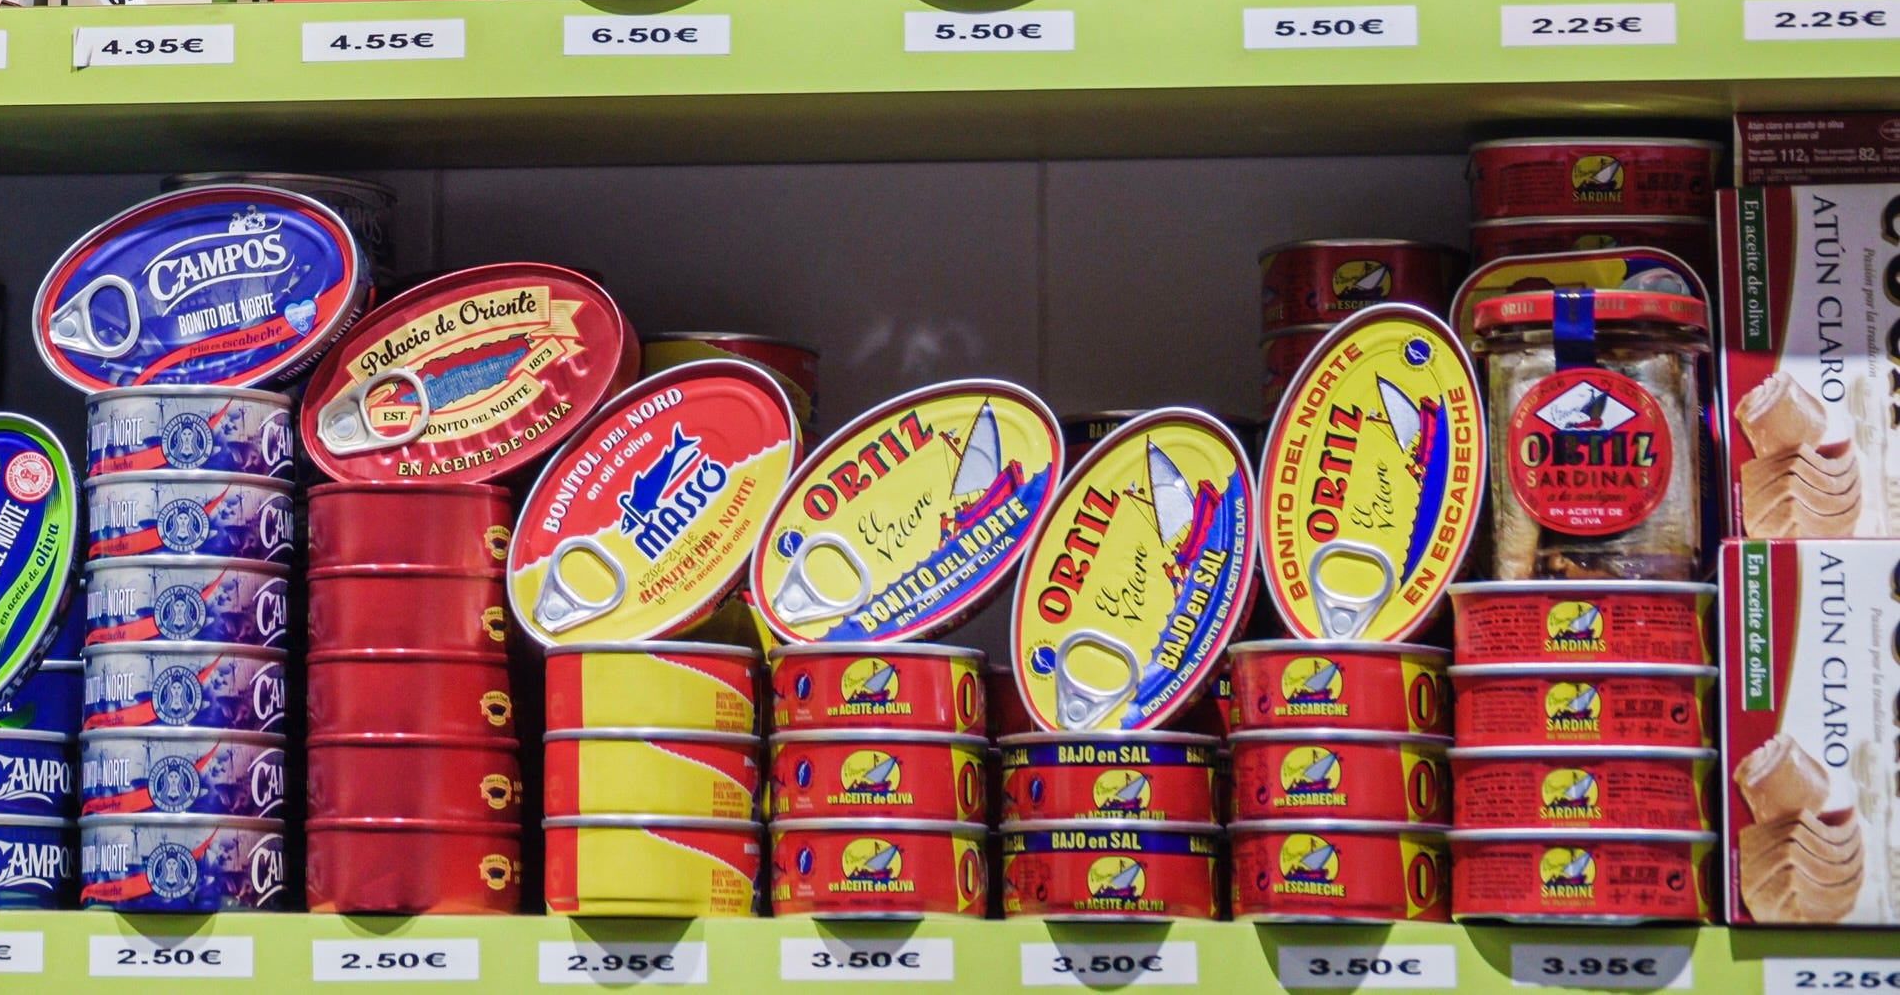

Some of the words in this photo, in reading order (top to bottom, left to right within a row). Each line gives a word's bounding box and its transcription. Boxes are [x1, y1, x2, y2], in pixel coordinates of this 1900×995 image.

[1273, 18, 1385, 37] 5.50€
[1531, 16, 1643, 35] 2.25€
[1774, 10, 1888, 29] 2.25€
[329, 32, 435, 50] 4.55€
[591, 26, 699, 44] 6.50€
[934, 23, 1043, 40] 5.50€
[100, 38, 205, 55] 4.95€
[148, 233, 287, 302] CAMPOS
[178, 311, 217, 337] BONITO
[219, 304, 239, 326] DEL
[241, 294, 276, 321] NORTE
[360, 328, 431, 376] Palacio
[435, 314, 456, 336] de
[460, 291, 537, 326] Oriente
[528, 348, 552, 371] 1873
[600, 427, 628, 453] DEL
[625, 387, 684, 429] NORD
[803, 410, 934, 522] ORTIZ
[1307, 403, 1363, 543] ORTIZ
[1435, 386, 1472, 561] ESCABECHE
[1820, 551, 1851, 645] ATÚN
[1544, 638, 1606, 653] SARDINAS
[1822, 656, 1850, 768] CLARO
[1058, 745, 1094, 763] BAJO
[1098, 747, 1116, 763] en
[1120, 745, 1149, 763] SAL
[116, 948, 223, 967] 2.50€
[340, 951, 448, 969] 2.50€
[566, 953, 675, 972] 2.95€
[810, 951, 921, 969] 3.50€
[1051, 954, 1164, 974] 3.50€
[1541, 957, 1658, 977] 3.95€
[1307, 957, 1423, 978] 3.50€
